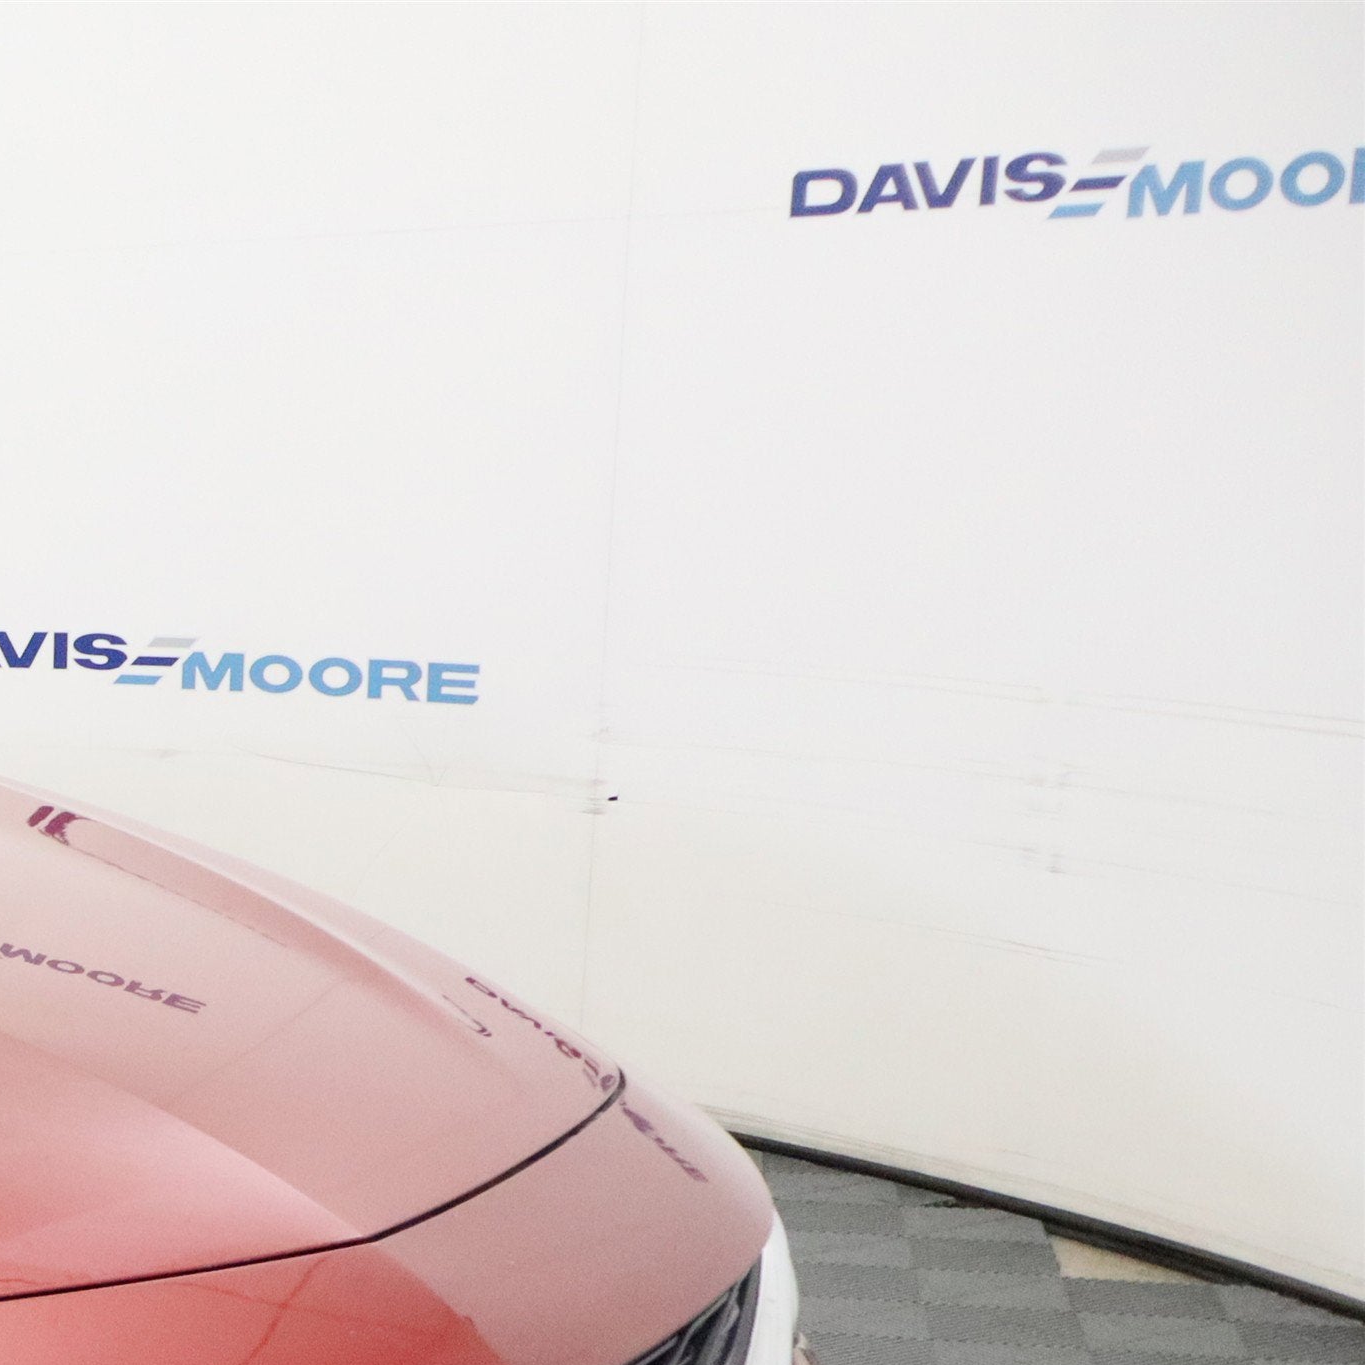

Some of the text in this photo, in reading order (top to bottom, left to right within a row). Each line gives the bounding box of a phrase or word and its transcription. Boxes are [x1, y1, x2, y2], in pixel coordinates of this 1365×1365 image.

[789, 146, 1365, 219] DAVIS MOO
[180, 650, 481, 705] MOORE
